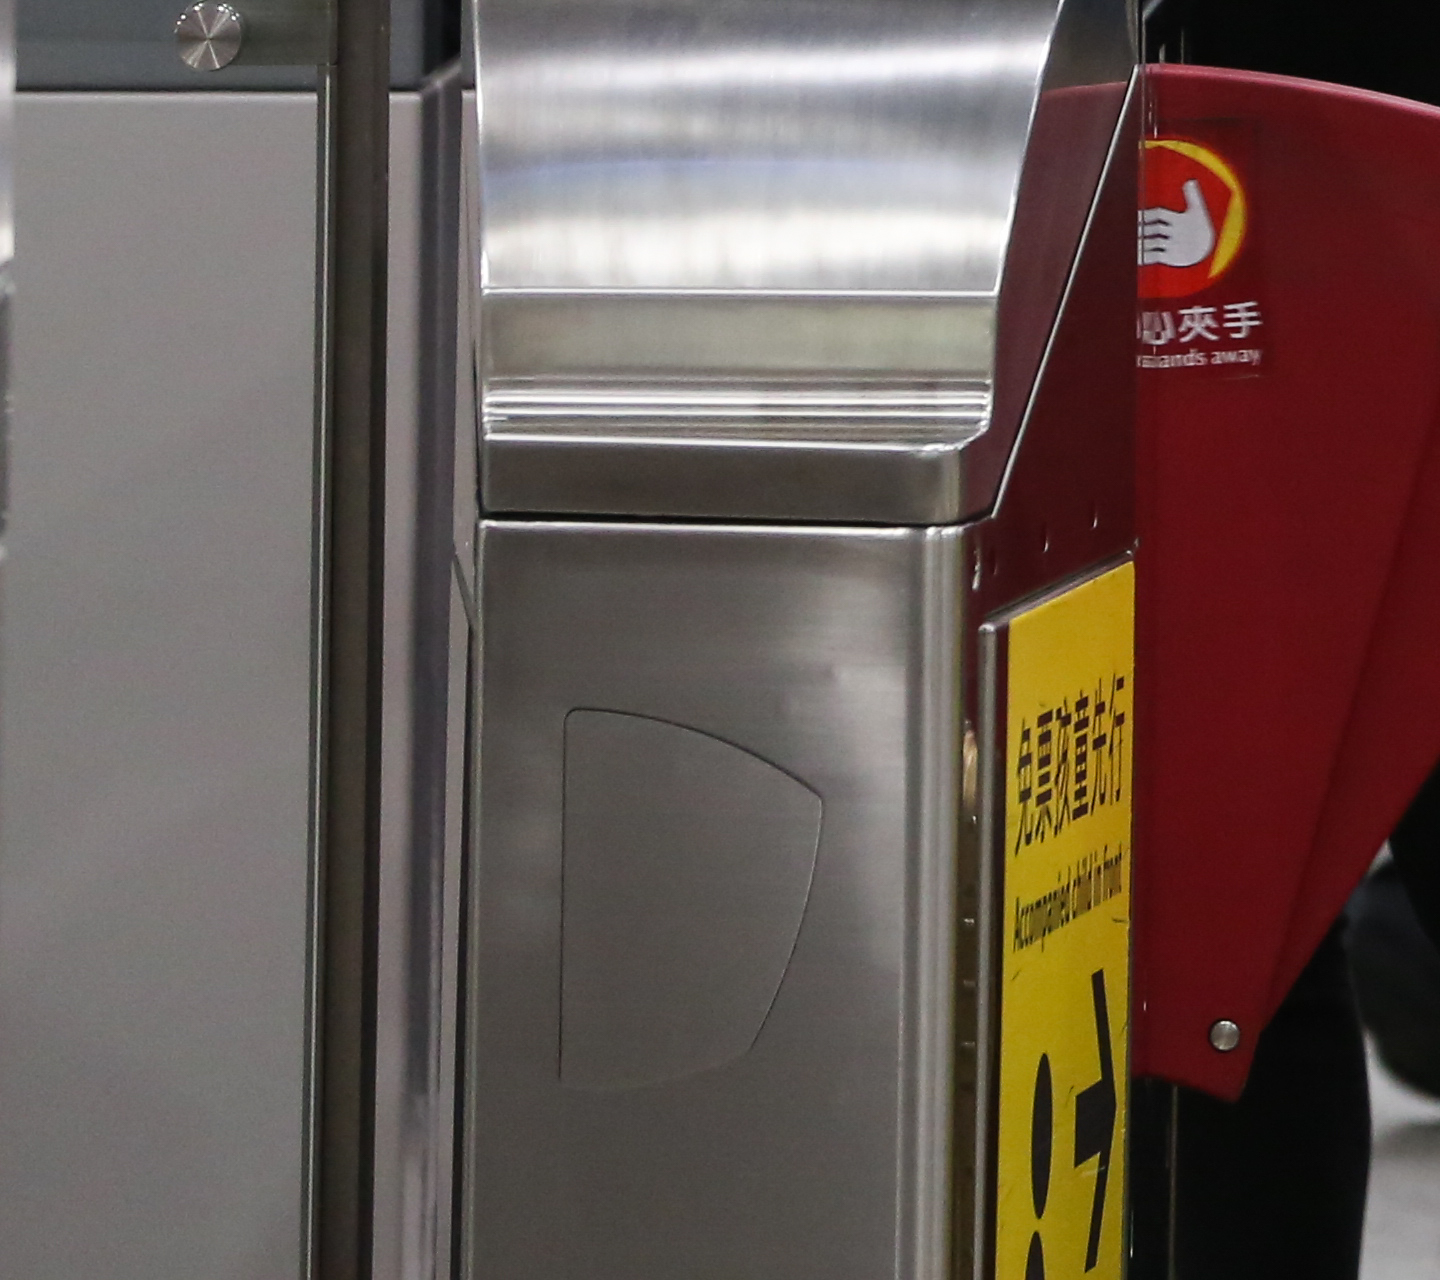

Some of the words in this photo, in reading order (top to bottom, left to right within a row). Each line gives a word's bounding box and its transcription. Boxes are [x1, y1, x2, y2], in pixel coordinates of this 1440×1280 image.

[1210, 349, 1263, 367] away
[1014, 672, 1126, 858] 免票孩童先行
[1012, 865, 1072, 953] Accompanied
